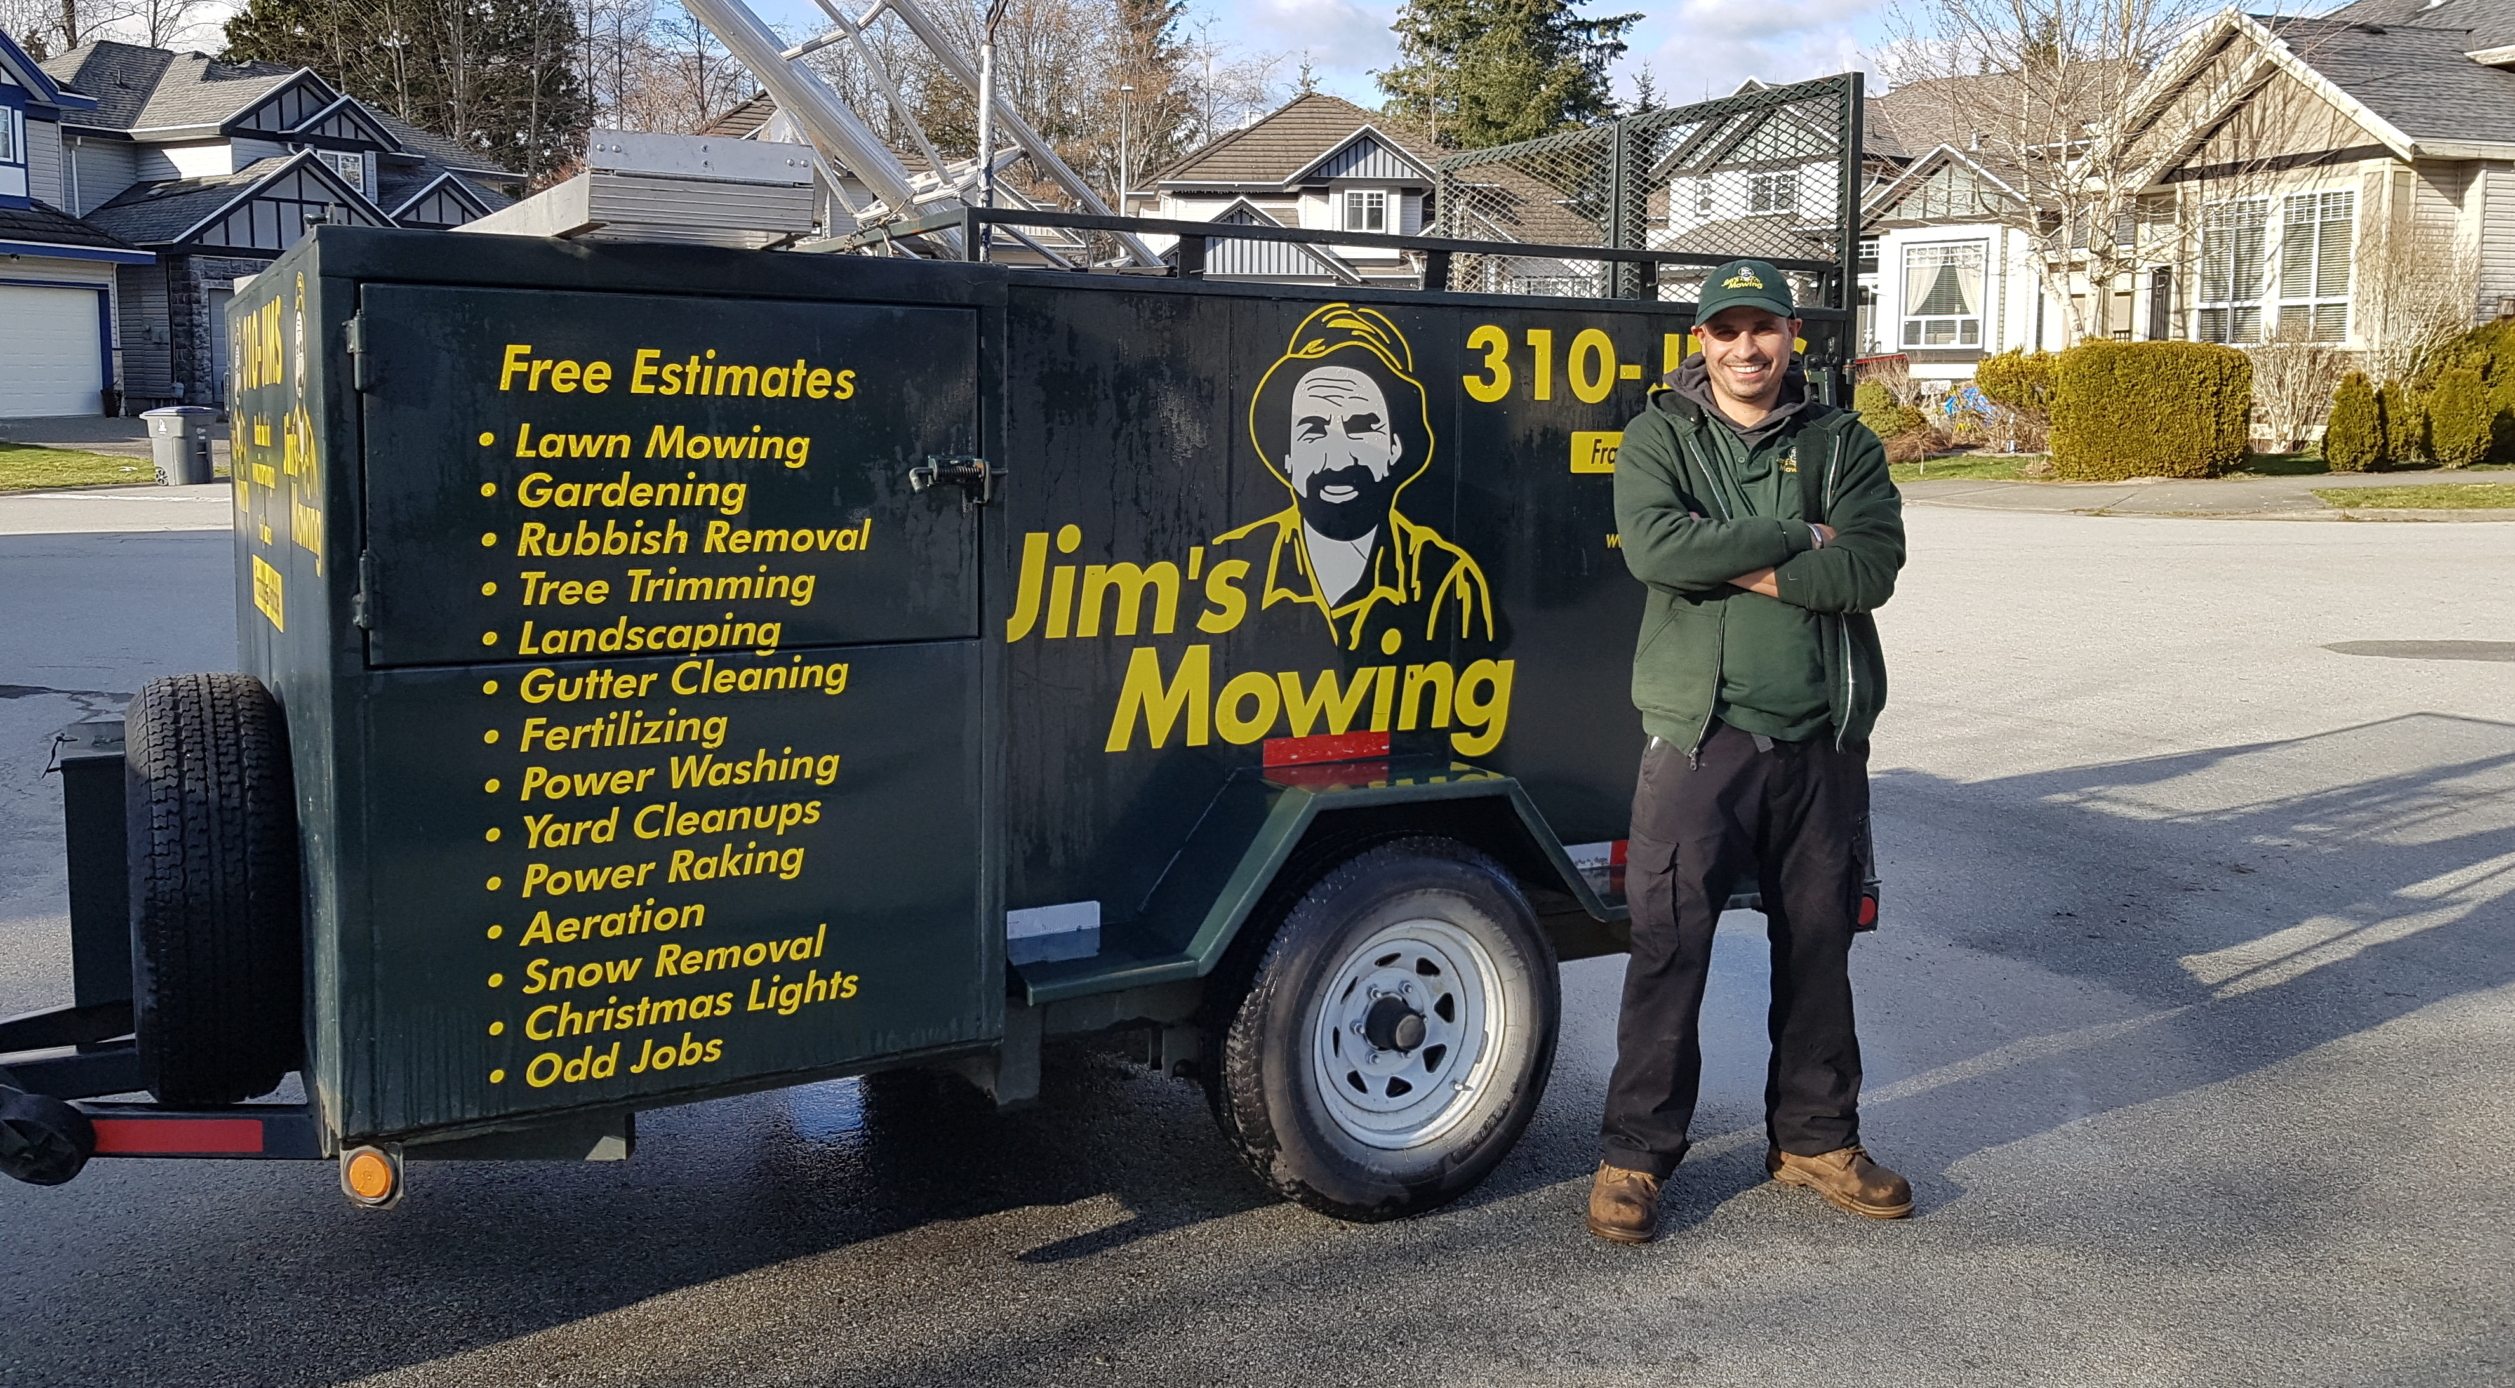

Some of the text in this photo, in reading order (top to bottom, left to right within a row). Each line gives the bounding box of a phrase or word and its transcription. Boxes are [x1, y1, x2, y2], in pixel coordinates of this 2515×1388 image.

[1728, 281, 1763, 290] Mowing
[499, 344, 856, 400] Free Estimates
[515, 423, 810, 469] Lawn Mowing
[517, 470, 747, 516] Gardening
[291, 482, 322, 578] Mowing
[517, 517, 872, 557] Rubbish Removal
[520, 564, 816, 607] Tree Trimming
[1006, 523, 1251, 643] Jim's
[518, 612, 782, 657] Landscaping
[519, 655, 849, 704] Gutter Cleaning
[1105, 628, 1516, 757] Mowing
[520, 707, 729, 753] Fertilizing
[520, 746, 841, 802] Power Washing
[522, 800, 822, 850] Yard Cleanups
[521, 840, 806, 899] Power Raking
[518, 898, 706, 947] Aeration
[521, 923, 827, 995] Snow Removal
[524, 969, 860, 1042] Christmas Lights
[525, 1031, 724, 1088] Odd Jobs
